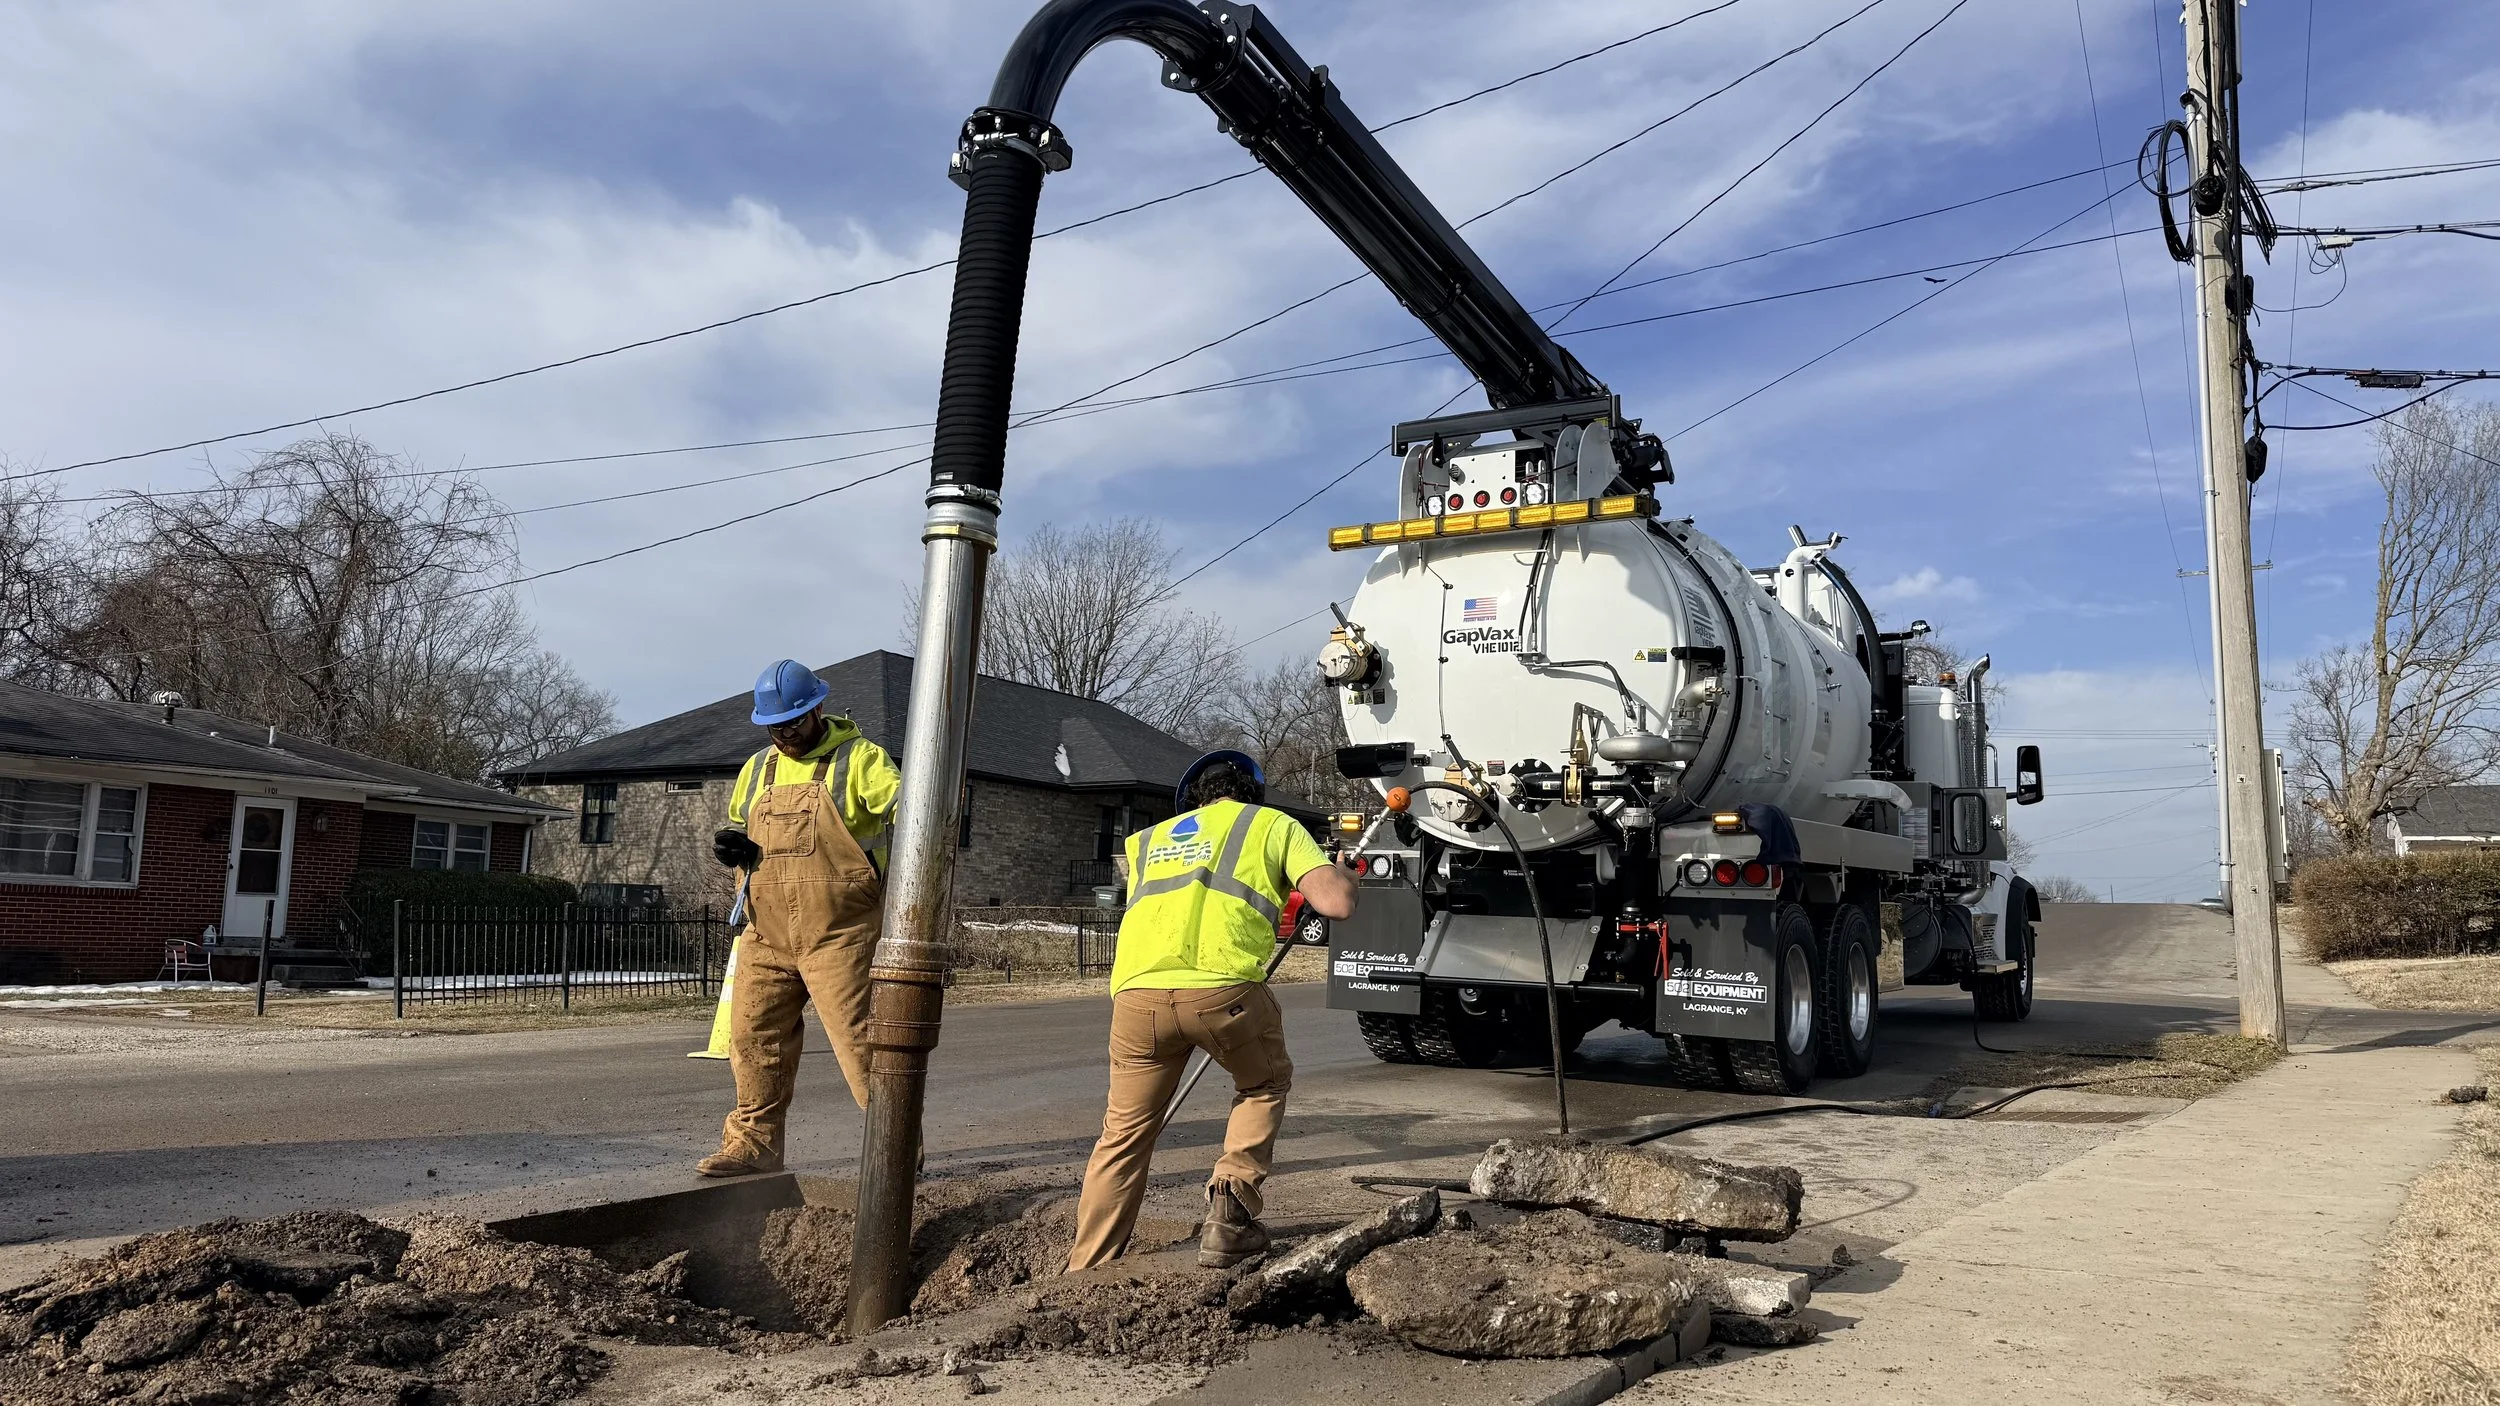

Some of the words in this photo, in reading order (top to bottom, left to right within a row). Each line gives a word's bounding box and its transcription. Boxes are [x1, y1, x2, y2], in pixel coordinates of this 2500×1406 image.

[1443, 627, 1515, 646] GapVax
[1340, 950, 1357, 960] Sold
[1357, 950, 1365, 960] &
[1365, 952, 1397, 962] Serviced
[1397, 953, 1409, 964] By
[1335, 963, 1355, 974] 502
[1671, 967, 1694, 977] Sold
[1694, 968, 1702, 978] &
[1703, 969, 1744, 982] Serviced
[1745, 971, 1759, 985] By
[1348, 982, 1389, 992] LAGRANGE,
[1666, 981, 1690, 993] 502
[1693, 983, 1765, 1000] EQUIPMENT
[1683, 1002, 1735, 1016] LAGRANGE,
[1736, 1007, 1749, 1015] KY
